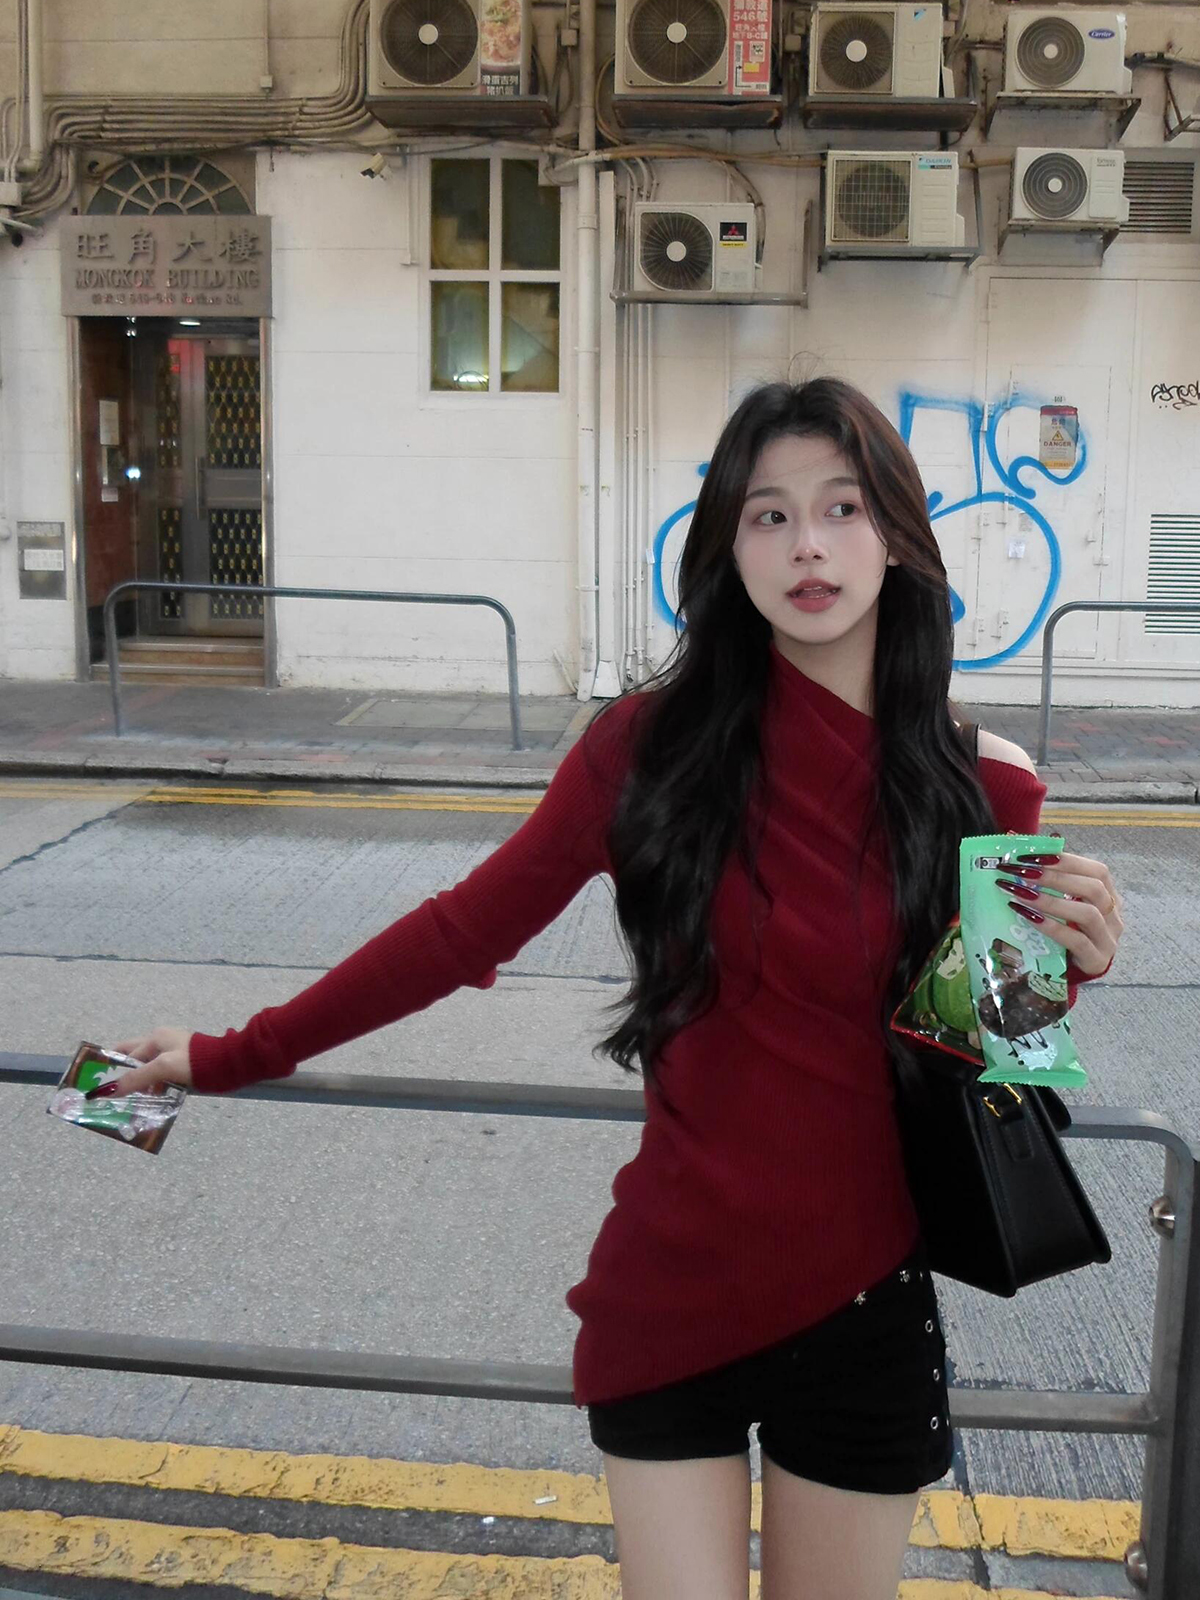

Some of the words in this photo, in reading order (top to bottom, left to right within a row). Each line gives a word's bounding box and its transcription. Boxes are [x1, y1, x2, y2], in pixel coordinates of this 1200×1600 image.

[76, 228, 265, 265] 旺角大樓
[76, 269, 156, 289] MONGKOK
[166, 269, 261, 289] BUILDING
